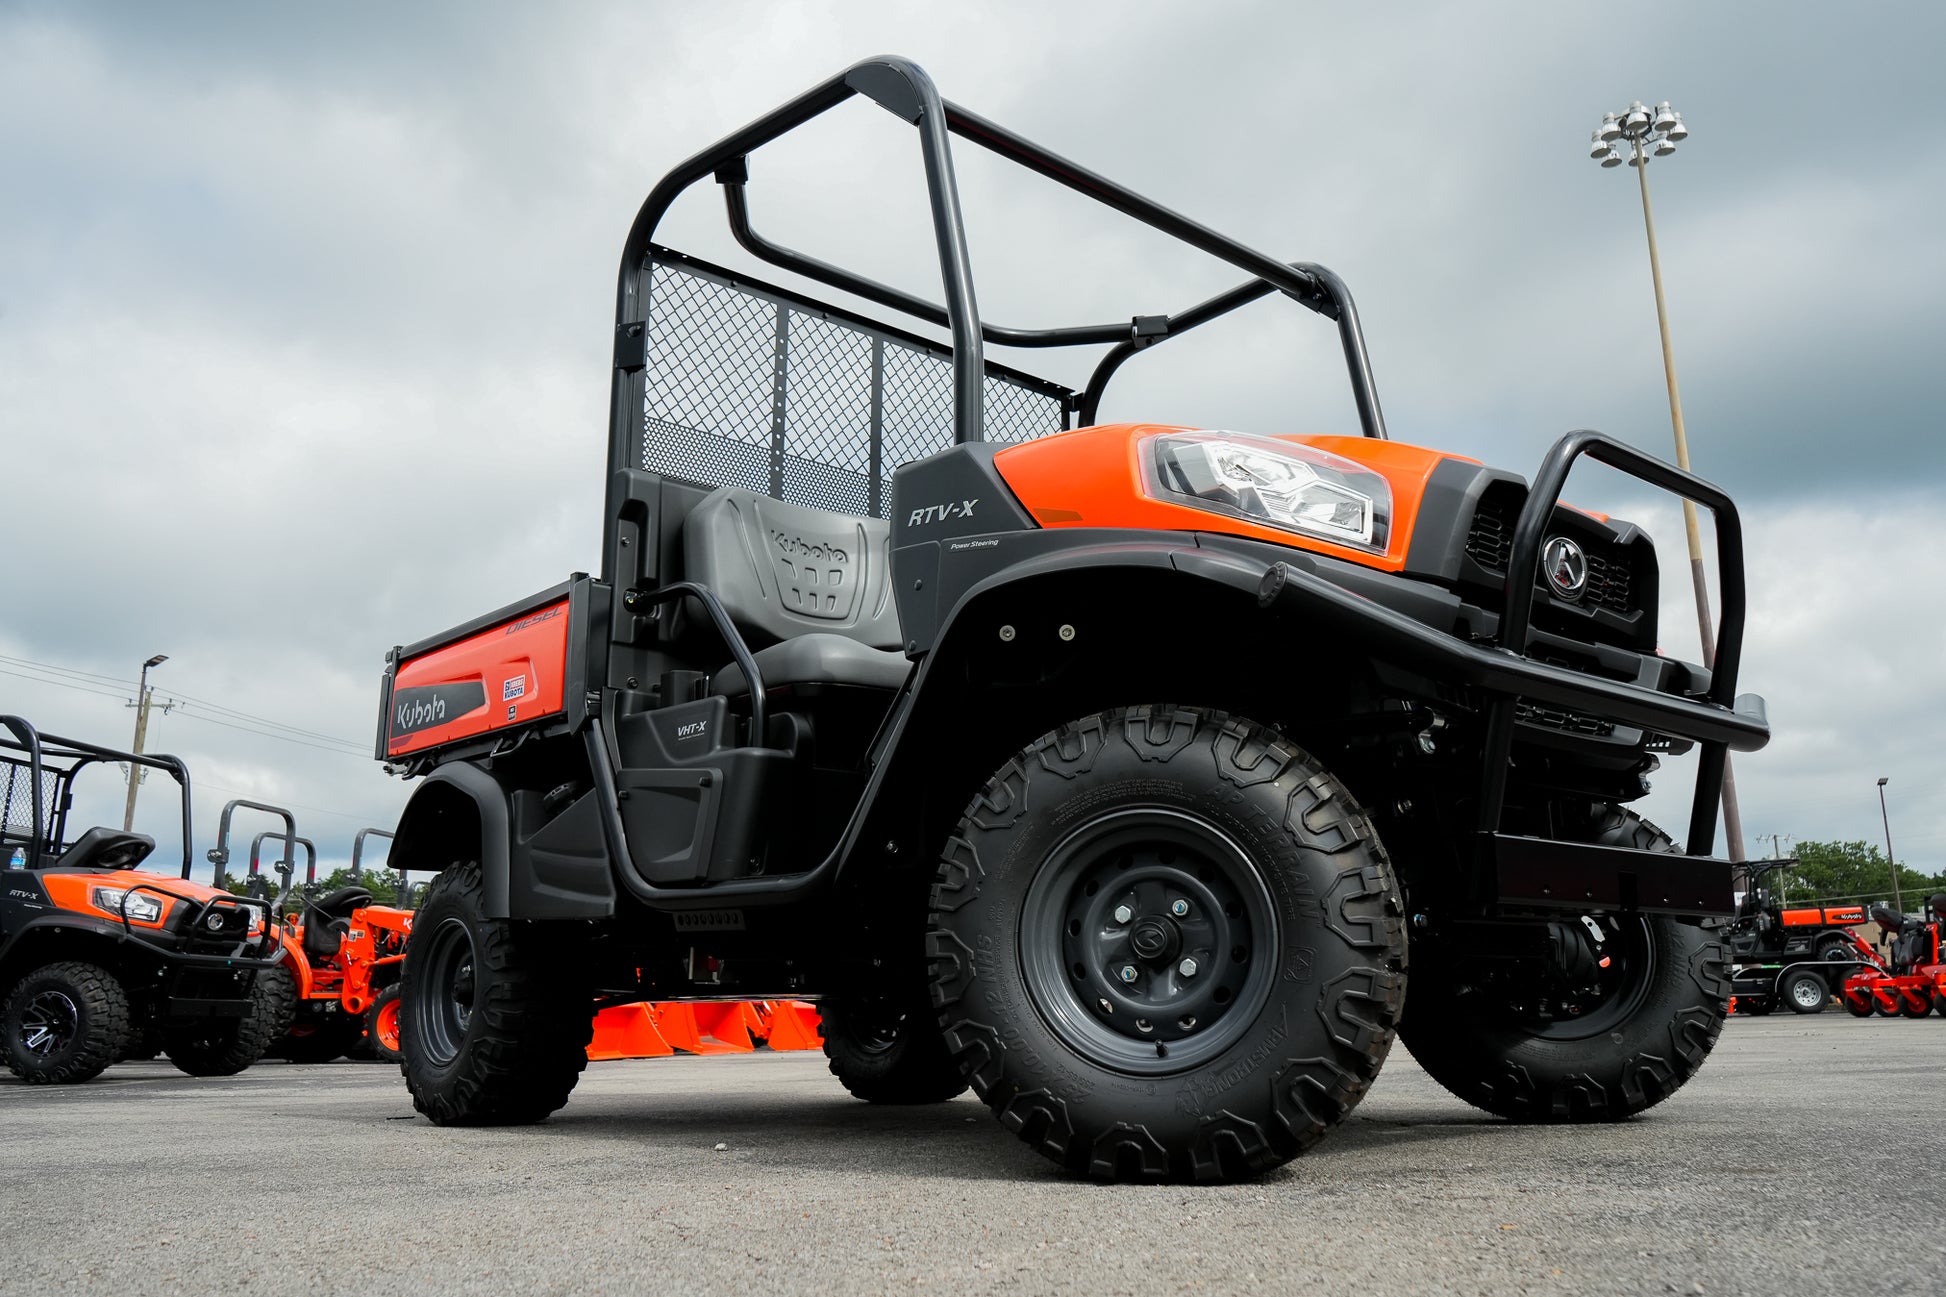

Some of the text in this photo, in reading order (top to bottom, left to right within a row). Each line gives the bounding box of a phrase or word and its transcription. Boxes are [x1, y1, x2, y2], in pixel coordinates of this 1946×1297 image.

[907, 499, 979, 527] RTV-X
[770, 529, 848, 563] Kubota
[950, 539, 999, 550] Power Steering
[505, 607, 562, 635] DIESEL
[397, 694, 445, 729] Kubota
[678, 720, 707, 737] VHT-X
[9, 889, 38, 900] RTV-X
